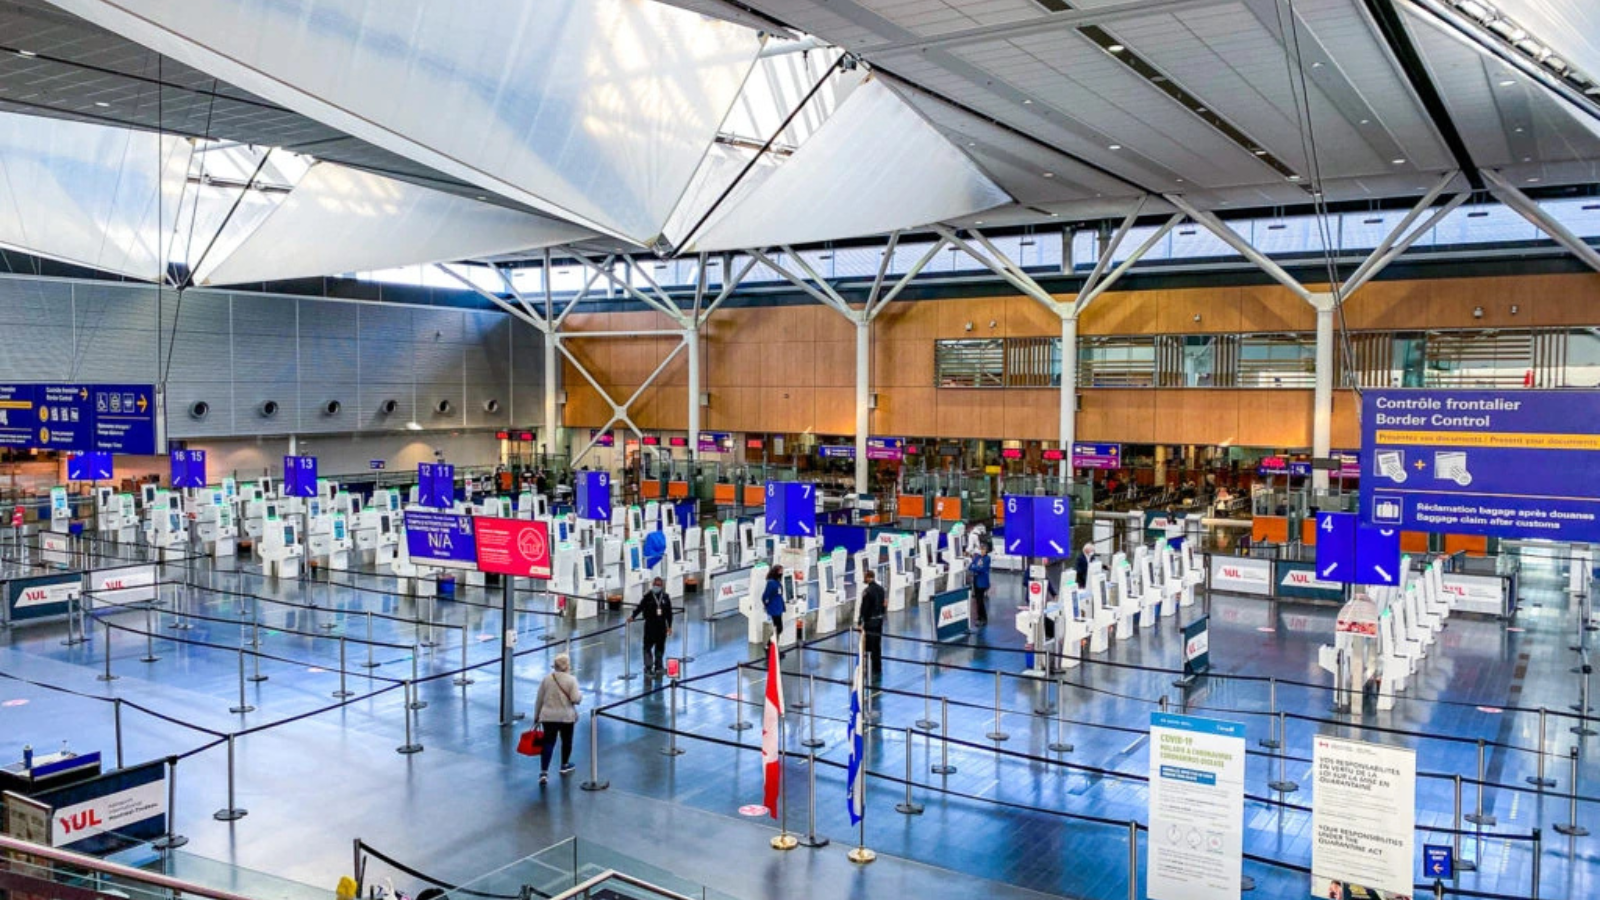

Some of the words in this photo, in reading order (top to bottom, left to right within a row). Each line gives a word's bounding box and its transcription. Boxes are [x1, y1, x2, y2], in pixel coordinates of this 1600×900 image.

[1376, 396, 1441, 410] Contrôle
[1446, 397, 1521, 411] frontalier
[1376, 413, 1427, 426] Border
[1431, 414, 1490, 427] Control
[174, 451, 185, 461] 16
[191, 451, 203, 462] 15
[301, 458, 313, 469] 13
[421, 465, 430, 477] 12
[437, 466, 449, 477] 11
[599, 474, 607, 487] 9
[768, 483, 774, 497] 8
[801, 485, 811, 499] 7
[1008, 498, 1017, 513] 6
[1053, 499, 1064, 515] 5
[1416, 502, 1477, 514] Réclamation
[1479, 506, 1516, 517] bagage
[1518, 508, 1546, 518] après
[1549, 510, 1595, 520] douanes
[1321, 515, 1334, 532] 4
[1416, 513, 1458, 524] Baggage
[1460, 514, 1487, 525] claim
[1490, 517, 1513, 526] after
[1515, 519, 1561, 529] customs
[427, 532, 454, 549] N/A
[1223, 568, 1241, 578] YUL
[1290, 573, 1310, 584] YUL
[25, 590, 47, 600] YUL
[1160, 734, 1193, 746] COVID-19
[1319, 757, 1334, 765] VOS
[1331, 765, 1354, 775] VERTU
[1356, 769, 1365, 777] DE
[1319, 776, 1371, 791] QUARANTAINE
[1333, 771, 1347, 779] SUR
[1359, 776, 1377, 785] MISE
[1379, 780, 1390, 788] EN
[59, 808, 102, 834] YUL
[1318, 824, 1338, 833] YOUR
[1340, 827, 1404, 847] RESPONSIBILITIES
[1318, 831, 1343, 841] UNDER
[1344, 835, 1358, 845] THE
[1318, 838, 1366, 852] QUARANTINE
[1368, 847, 1383, 856] ACT
